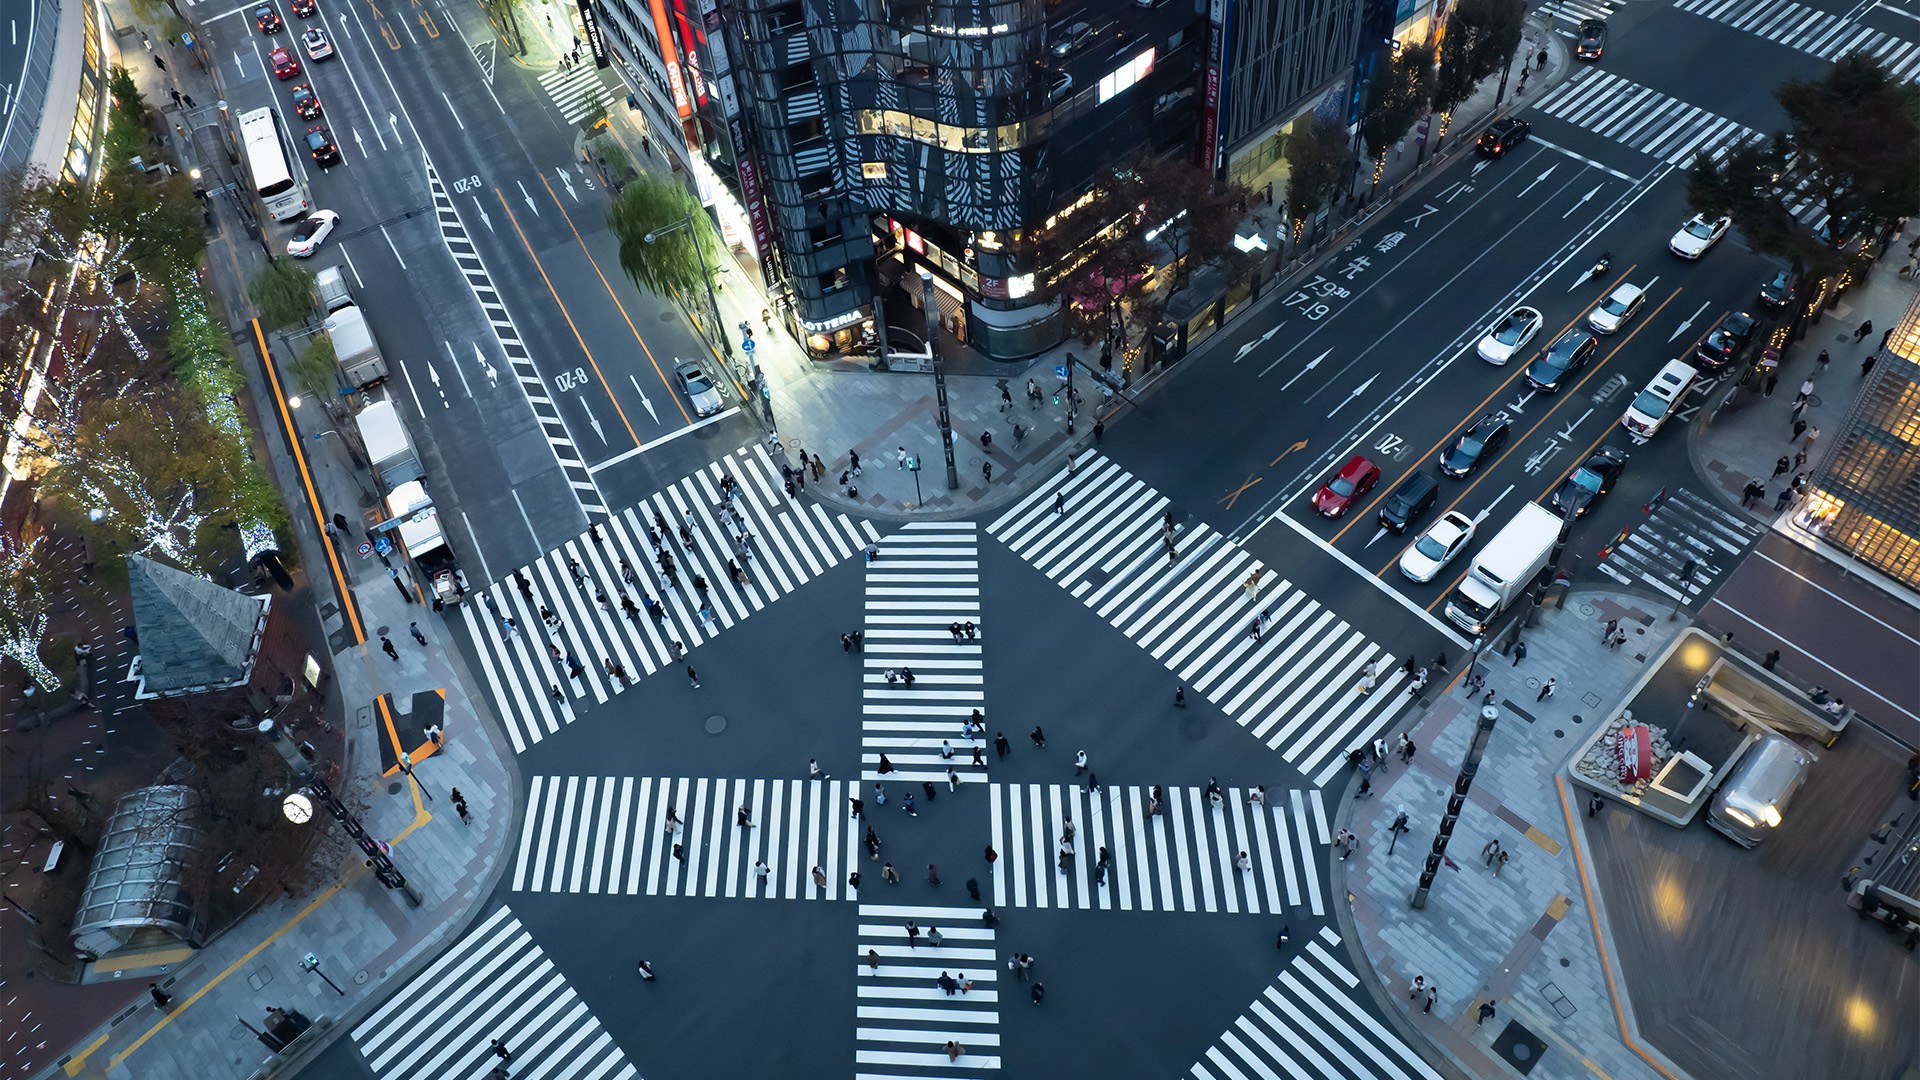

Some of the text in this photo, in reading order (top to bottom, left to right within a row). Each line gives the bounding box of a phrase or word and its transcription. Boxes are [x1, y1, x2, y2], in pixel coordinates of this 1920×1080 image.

[583, 8, 604, 58] THE SUIT COMPANY
[667, 61, 687, 107] BIG ECHO
[453, 175, 482, 194] 8-20
[766, 261, 776, 284] LOTTERIA
[986, 278, 999, 287] 2F
[1281, 291, 1330, 321] 17-19
[798, 310, 863, 332] LOTTERIA
[555, 366, 589, 393] 8-20
